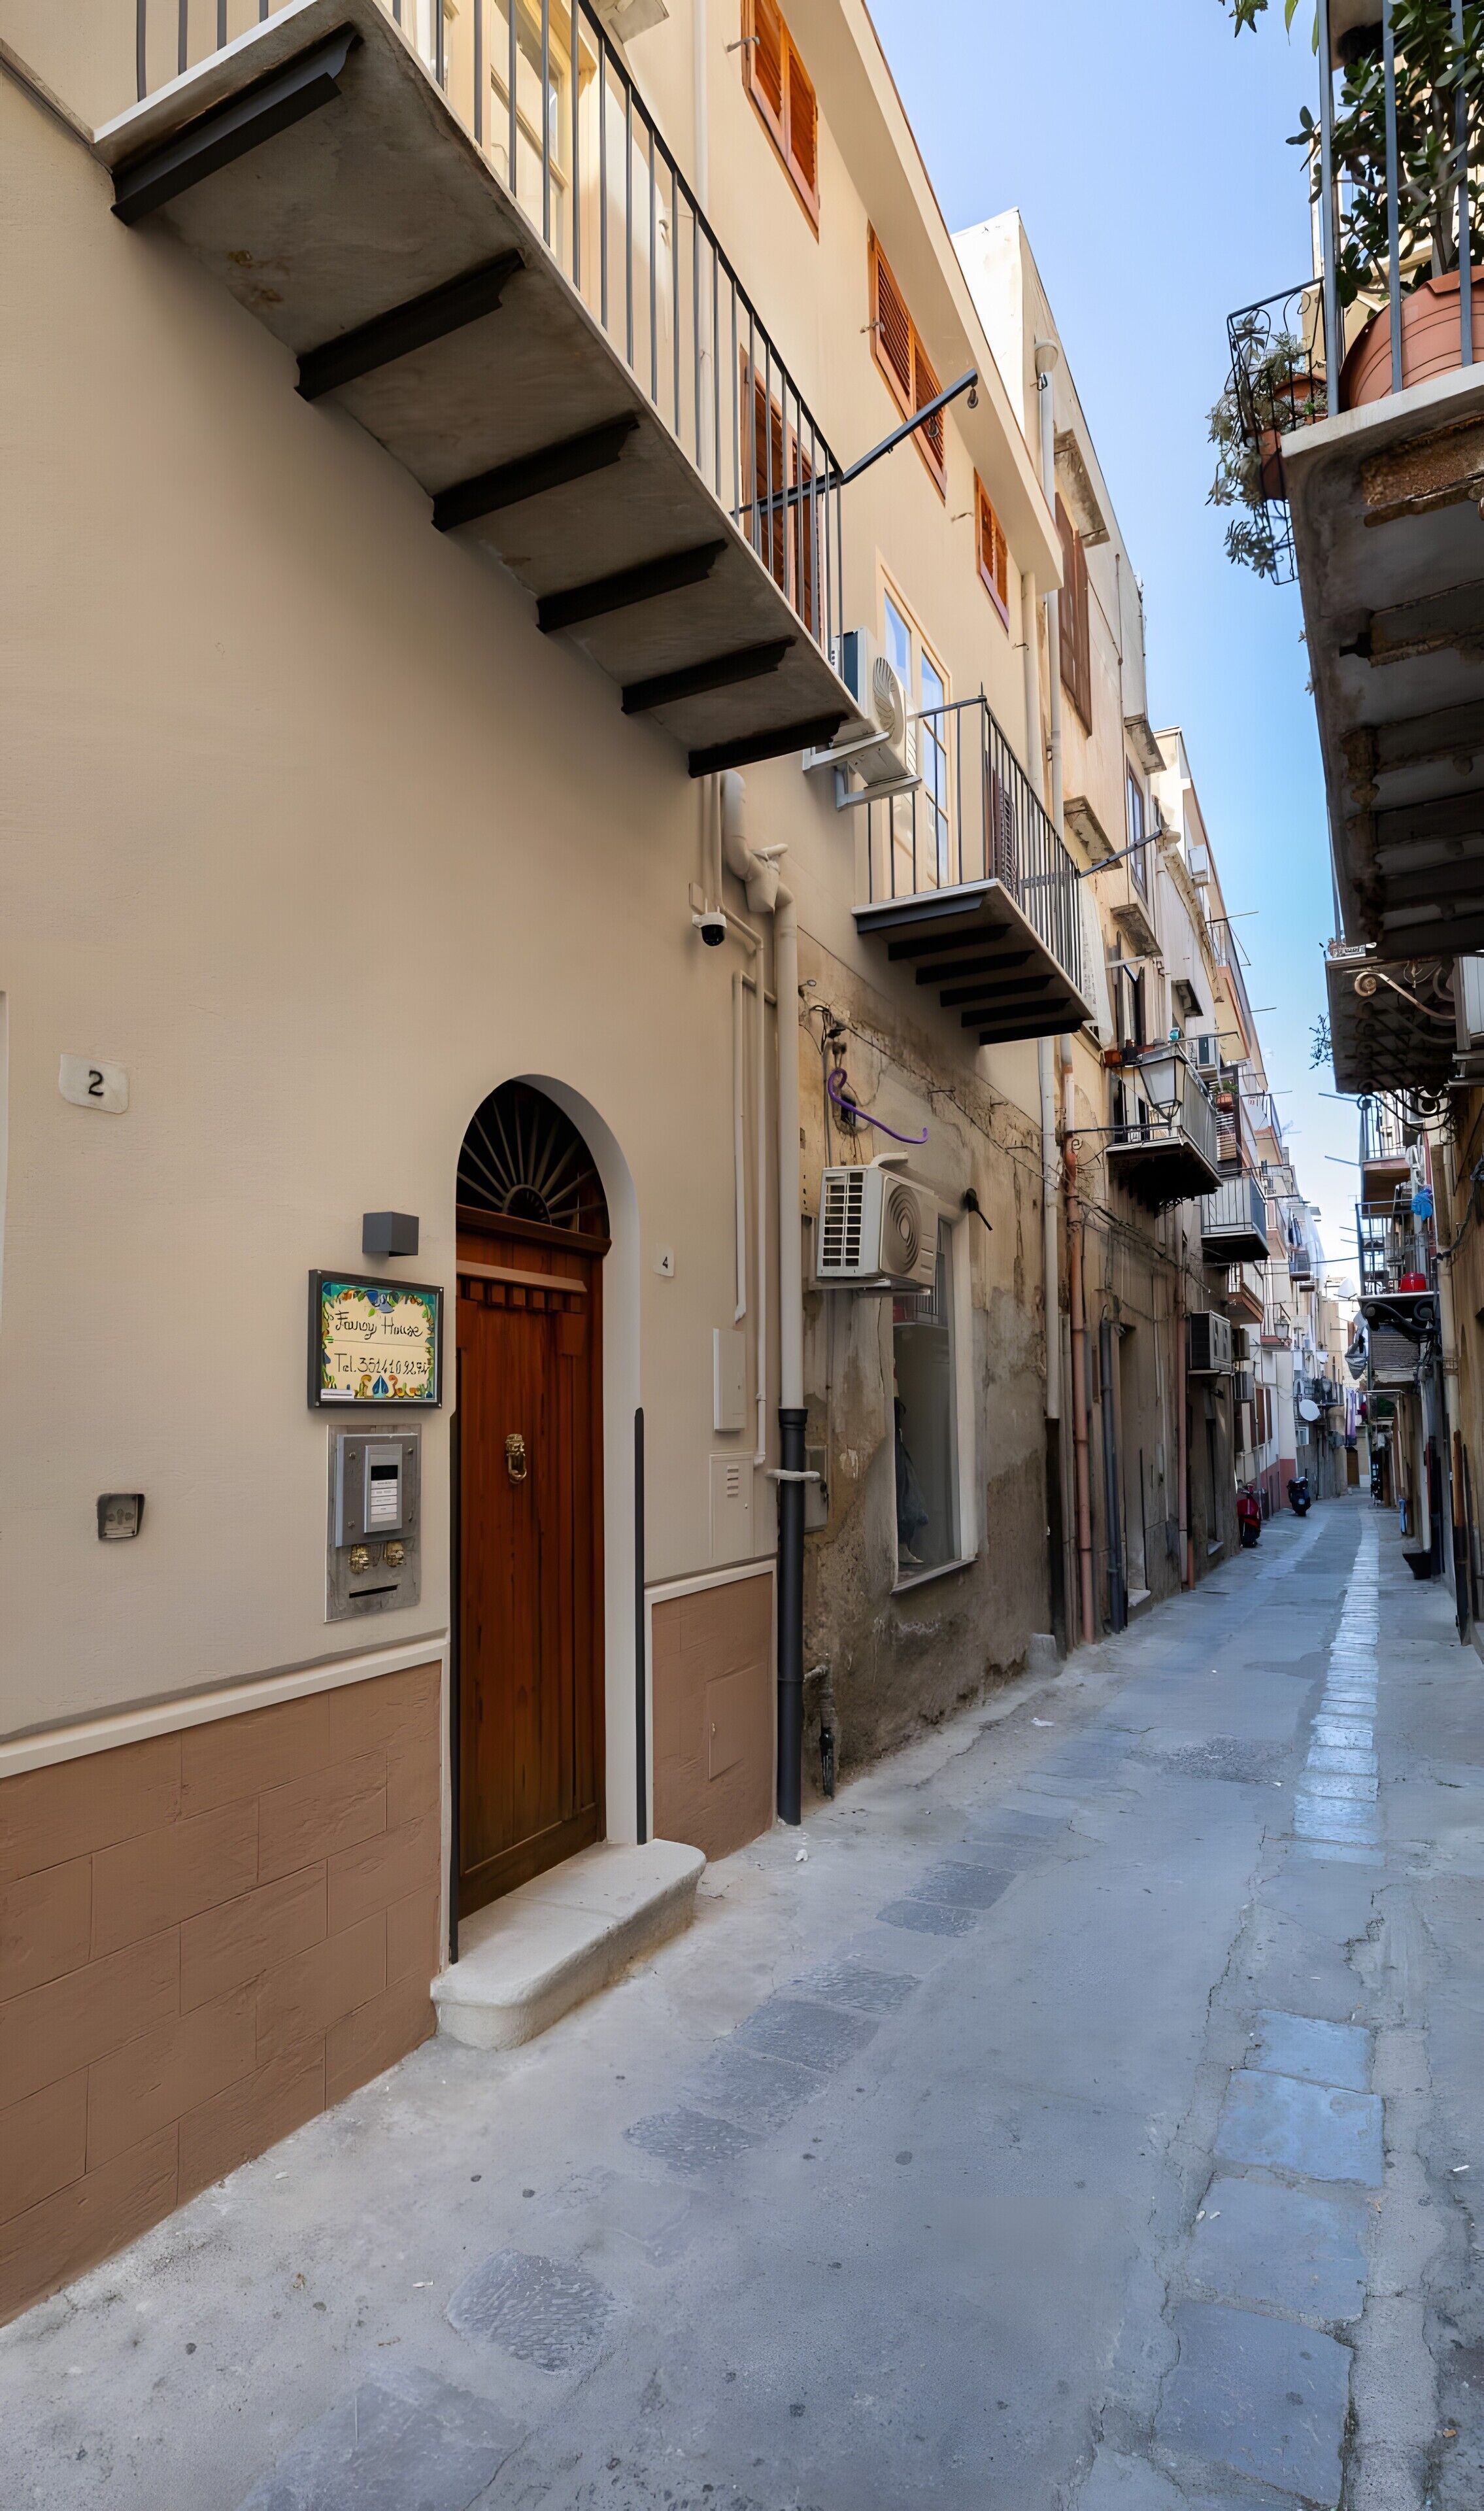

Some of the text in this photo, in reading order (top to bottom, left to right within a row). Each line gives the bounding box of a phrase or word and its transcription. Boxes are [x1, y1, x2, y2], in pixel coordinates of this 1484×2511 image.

[88, 1070, 104, 1097] 2
[662, 1256, 668, 1269] 4
[381, 1316, 423, 1337] House
